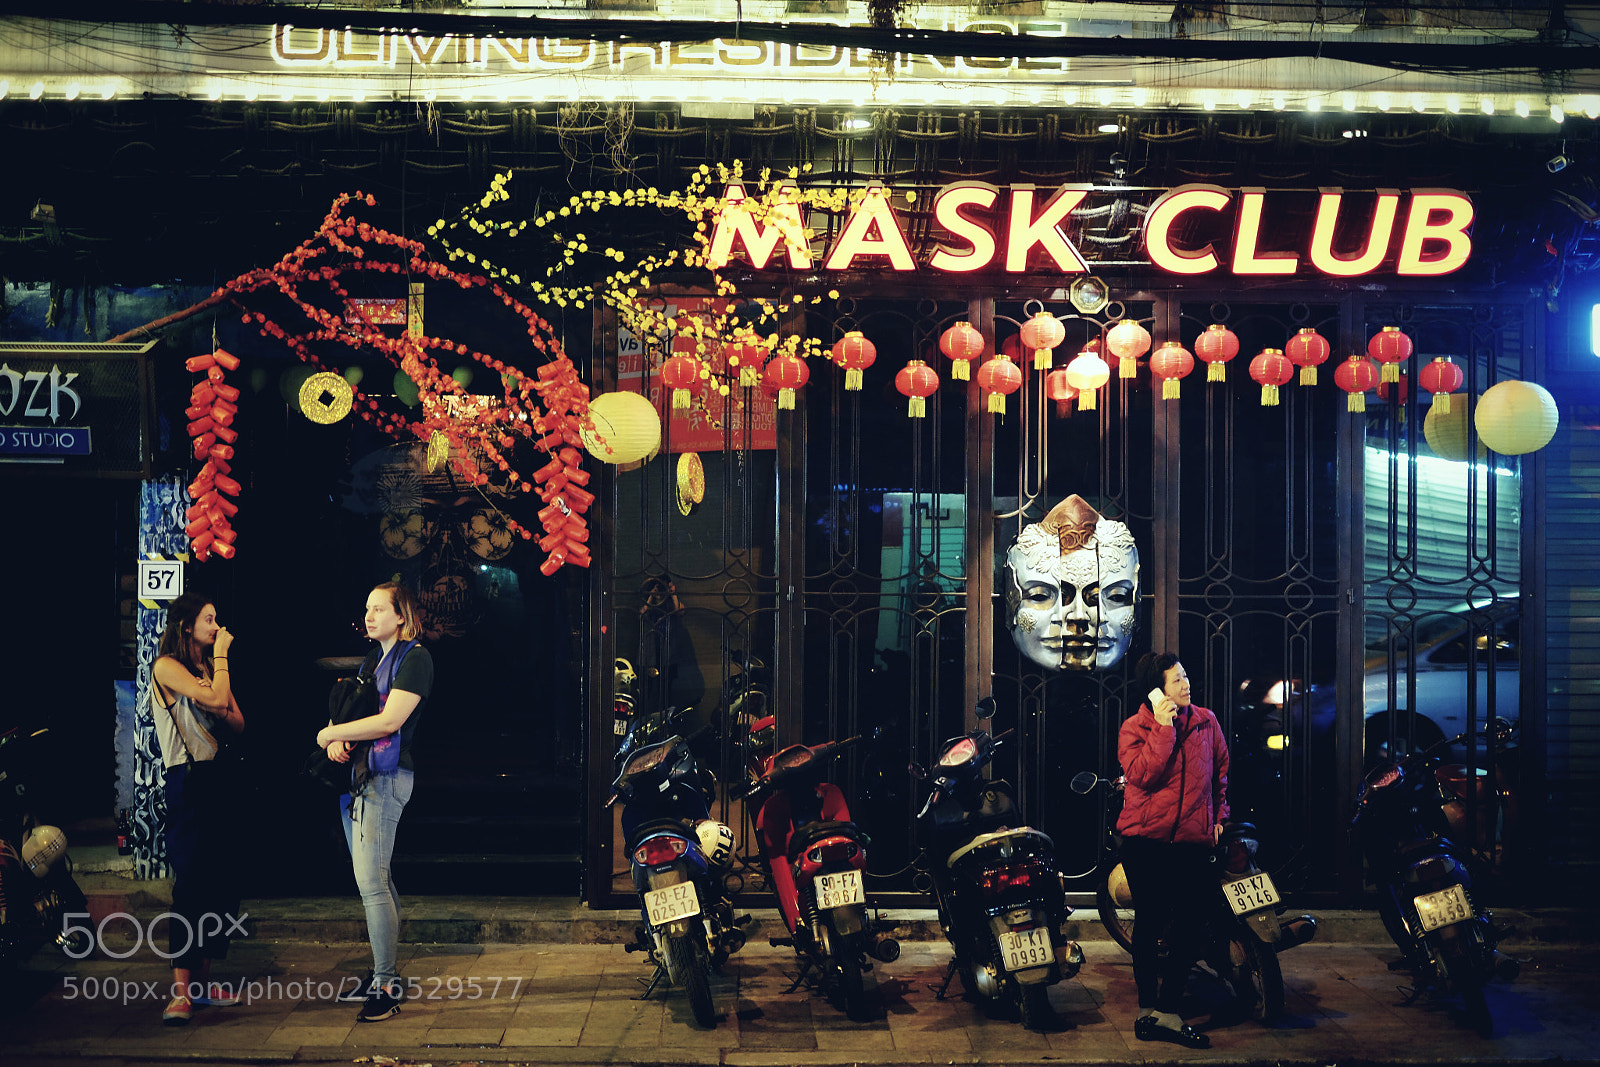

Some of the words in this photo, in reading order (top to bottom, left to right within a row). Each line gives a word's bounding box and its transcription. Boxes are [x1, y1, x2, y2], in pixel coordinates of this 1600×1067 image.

[707, 180, 1091, 273] MASK
[1143, 184, 1474, 276] CLUB
[12, 432, 75, 448] STUDIO
[147, 570, 175, 590] 57
[1230, 876, 1264, 897] 30-K7
[1237, 890, 1273, 911] 9146
[1007, 931, 1044, 951] 30-K1
[1010, 947, 1047, 967] 0993
